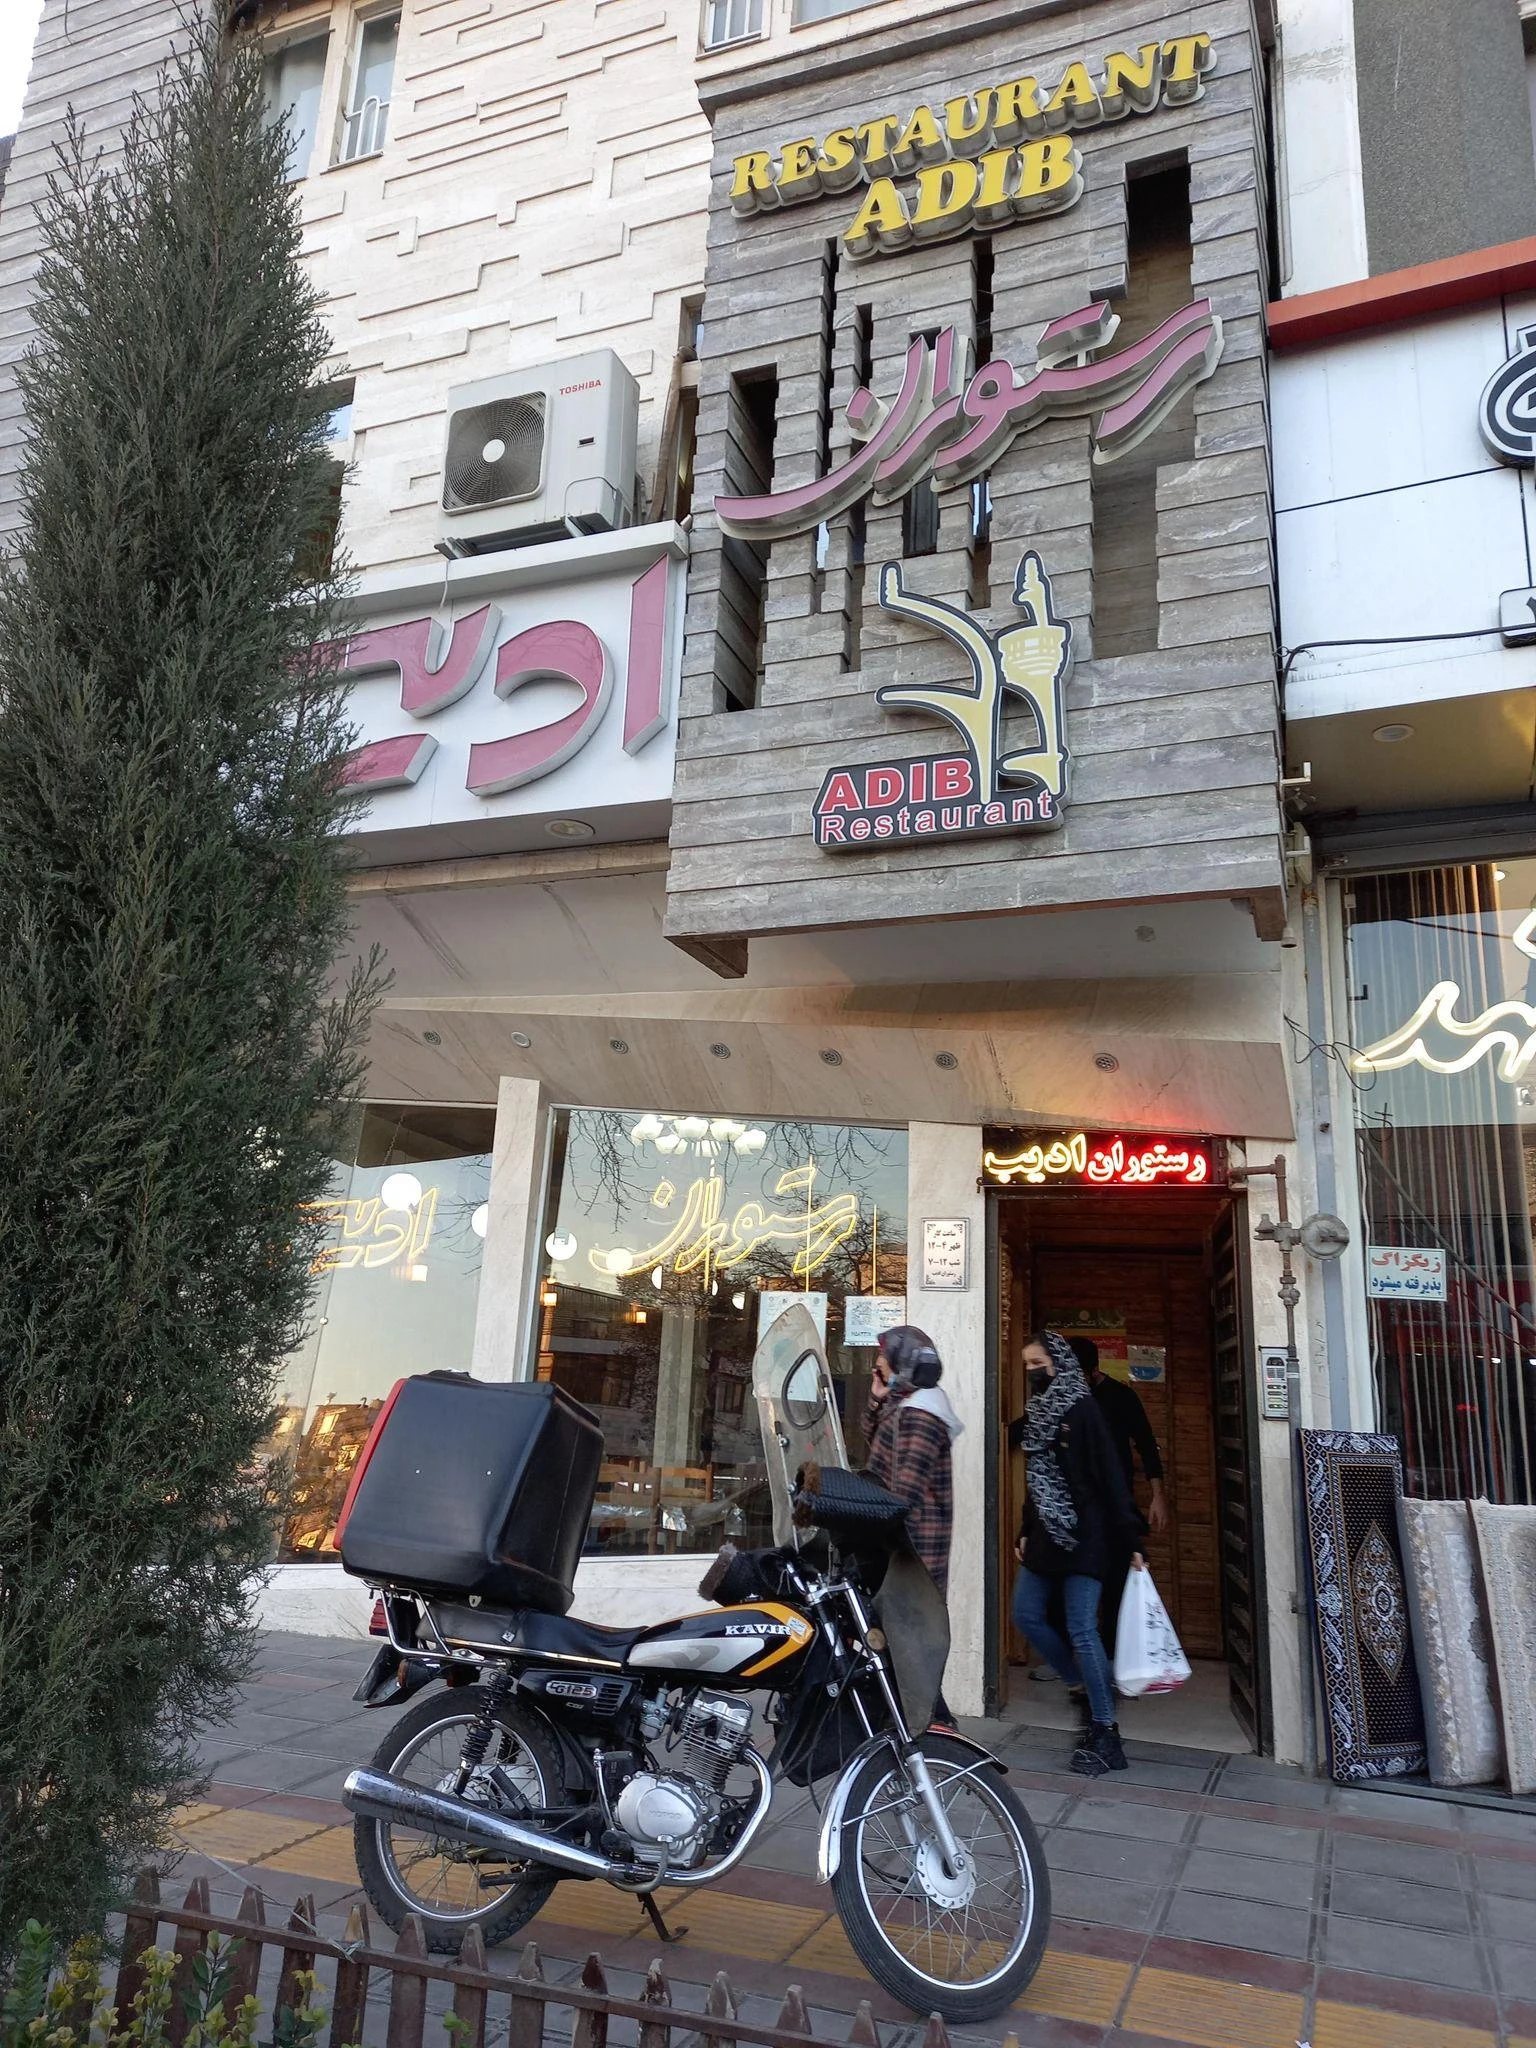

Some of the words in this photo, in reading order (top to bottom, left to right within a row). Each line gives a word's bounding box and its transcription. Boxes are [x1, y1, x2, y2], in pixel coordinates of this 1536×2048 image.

[730, 32, 1216, 206] RESTAURANT
[843, 133, 1080, 256] ADIB
[559, 379, 602, 395] TOSHIBA
[713, 298, 1218, 534] رستوران
[817, 758, 974, 815] ADIB
[820, 789, 1054, 844] Restaurant
[984, 1132, 1087, 1184] ادیب
[1087, 1140, 1208, 1182] رستوران
[588, 1164, 857, 1276] رستوران
[1371, 1251, 1442, 1273] زیگزاگ
[1371, 1275, 1402, 1292] میشود
[1404, 1275, 1442, 1296] پذیرفته
[725, 1623, 792, 1636] KAVIR
